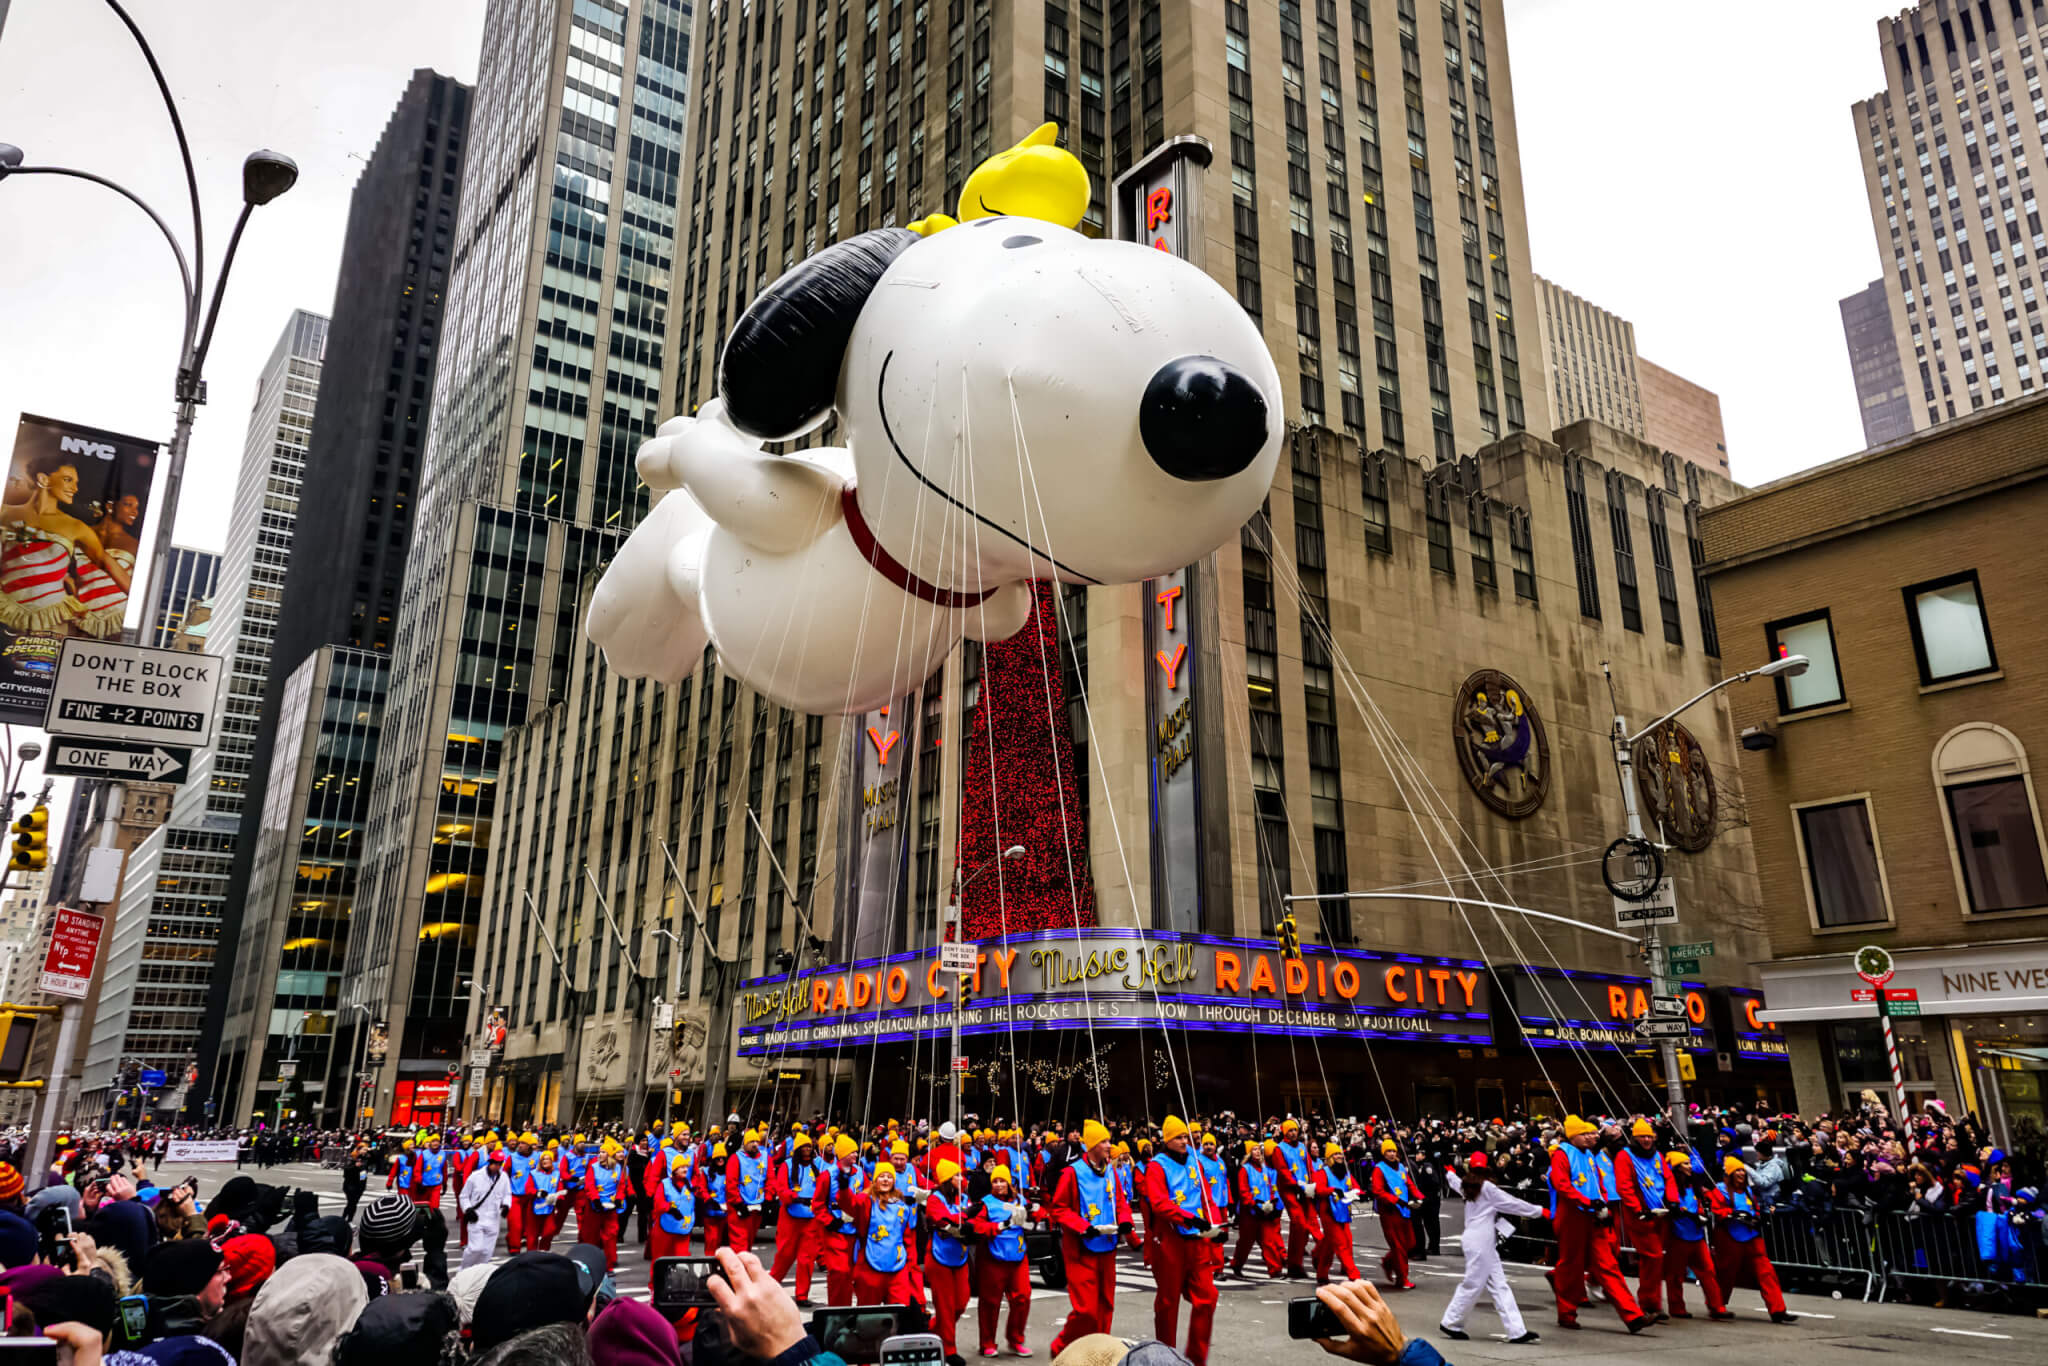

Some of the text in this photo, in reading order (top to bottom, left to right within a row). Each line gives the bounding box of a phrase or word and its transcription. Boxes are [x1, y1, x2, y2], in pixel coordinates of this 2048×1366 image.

[60, 435, 116, 460] NYC
[16, 636, 58, 647] CHRIST
[71, 653, 135, 674] DON'T
[141, 661, 209, 682] BLOCK
[96, 676, 183, 698] THE BOX
[65, 702, 198, 729] FINE +2 POINTS
[1158, 697, 1191, 751] MUSIC
[69, 750, 170, 771] ONE WAY
[1163, 733, 1192, 780] HALL
[60, 913, 100, 930] NO STANDING
[65, 926, 90, 938] ANYTIME
[1671, 947, 1712, 959] AMERICAS
[1030, 943, 1199, 990] Music Hall
[1676, 962, 1685, 974] 6
[743, 947, 1017, 1022] Music Hall RADIO CTY
[1215, 951, 1478, 1007] RADIO CITY
[1943, 971, 2001, 993] NINE
[1607, 985, 1706, 1024] RAO
[740, 1035, 759, 1046] CHASE
[764, 1031, 788, 1046] RADIO
[791, 1027, 809, 1042] CITY
[813, 1023, 858, 1040] CHRISTMAS
[863, 1015, 928, 1034] SPECTACULAR
[934, 1008, 983, 1027] STARING
[990, 1006, 1009, 1022] THE
[1155, 1003, 1188, 1018] NOW
[1198, 1005, 1261, 1022] THROUGH
[1268, 1009, 1337, 1027] DECEMBER
[1344, 1014, 1356, 1027] 31
[1363, 1016, 1433, 1032] #JOYTOALL
[1556, 1027, 1575, 1040] JOE
[1580, 1028, 1637, 1043] BONAMASSA
[1640, 1023, 1684, 1033] ONE WAY
